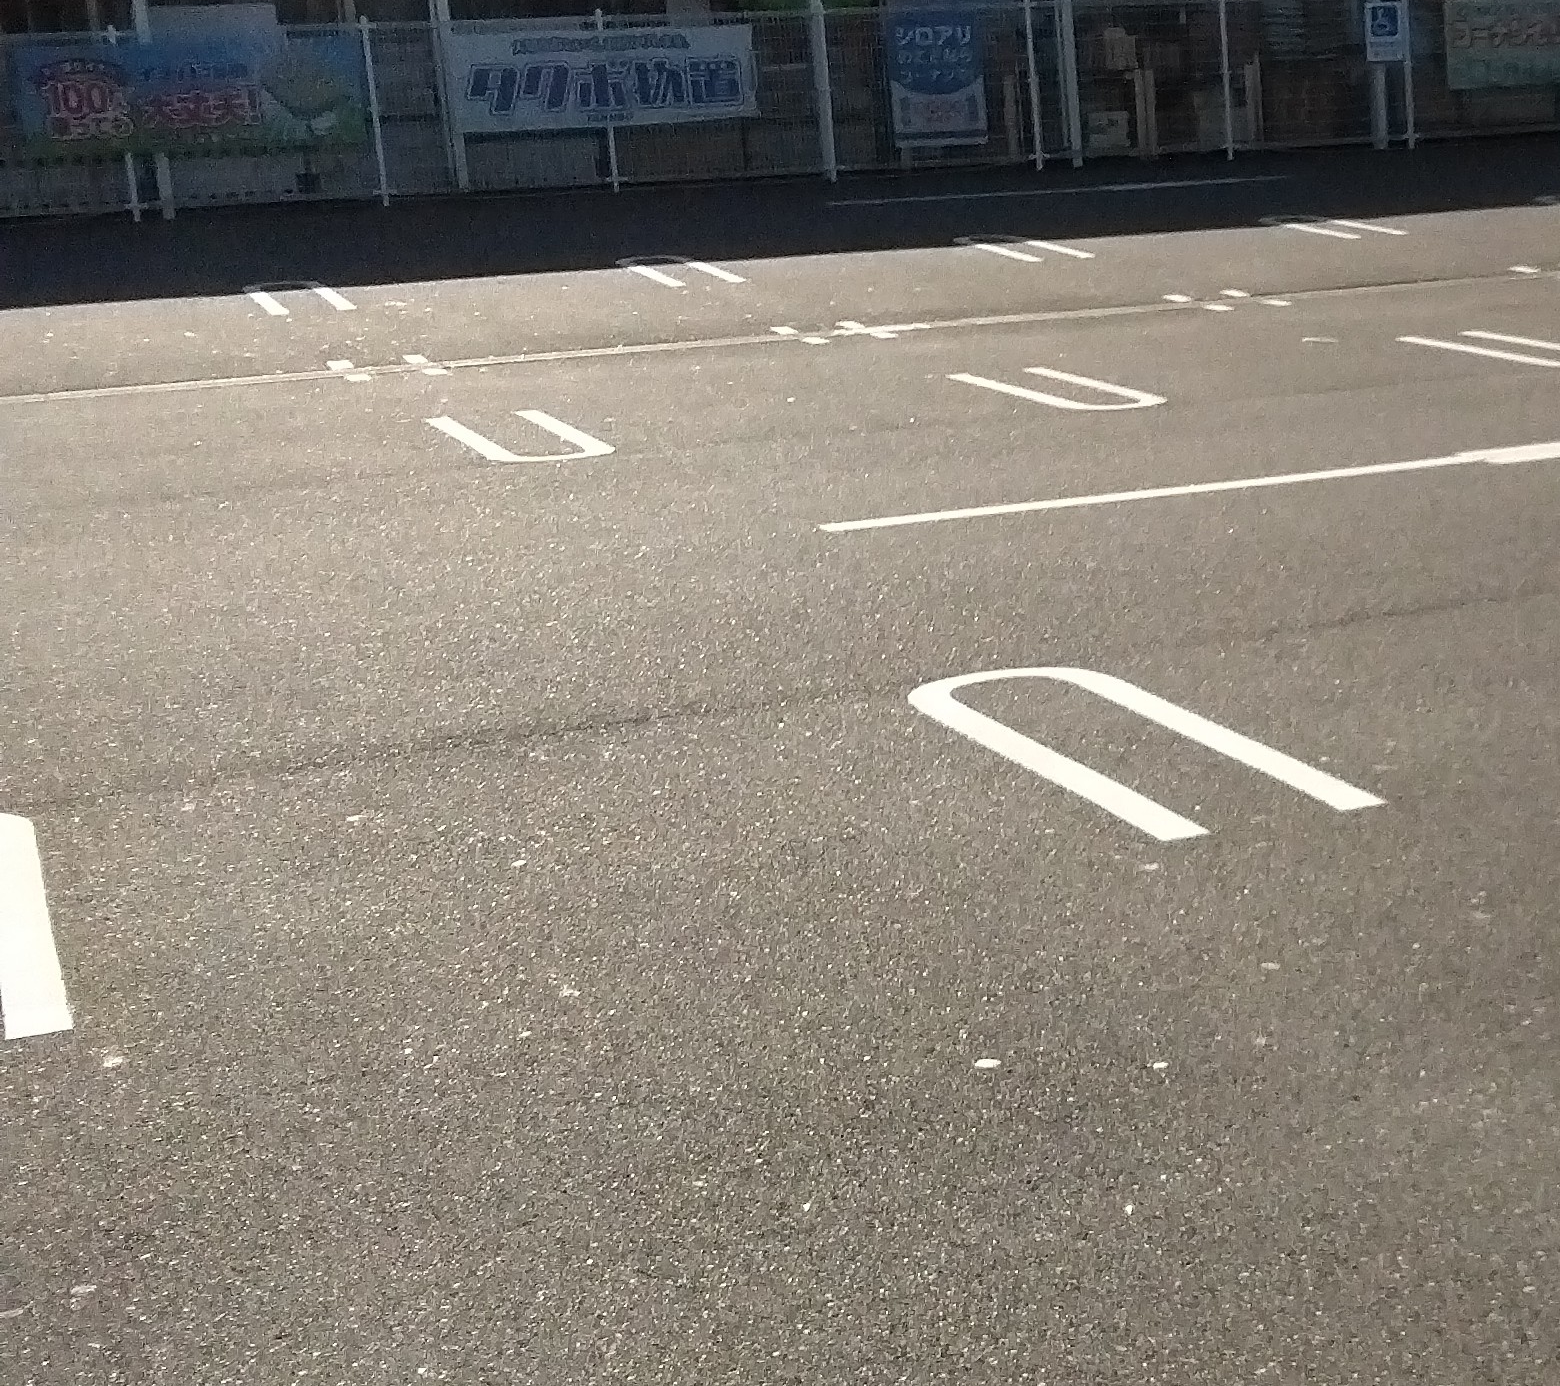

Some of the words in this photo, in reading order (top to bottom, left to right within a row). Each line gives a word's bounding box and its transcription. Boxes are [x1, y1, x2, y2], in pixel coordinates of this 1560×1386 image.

[895, 25, 972, 46] シロアリ
[465, 58, 744, 116] タクボ物置
[900, 68, 972, 85] コーナン
